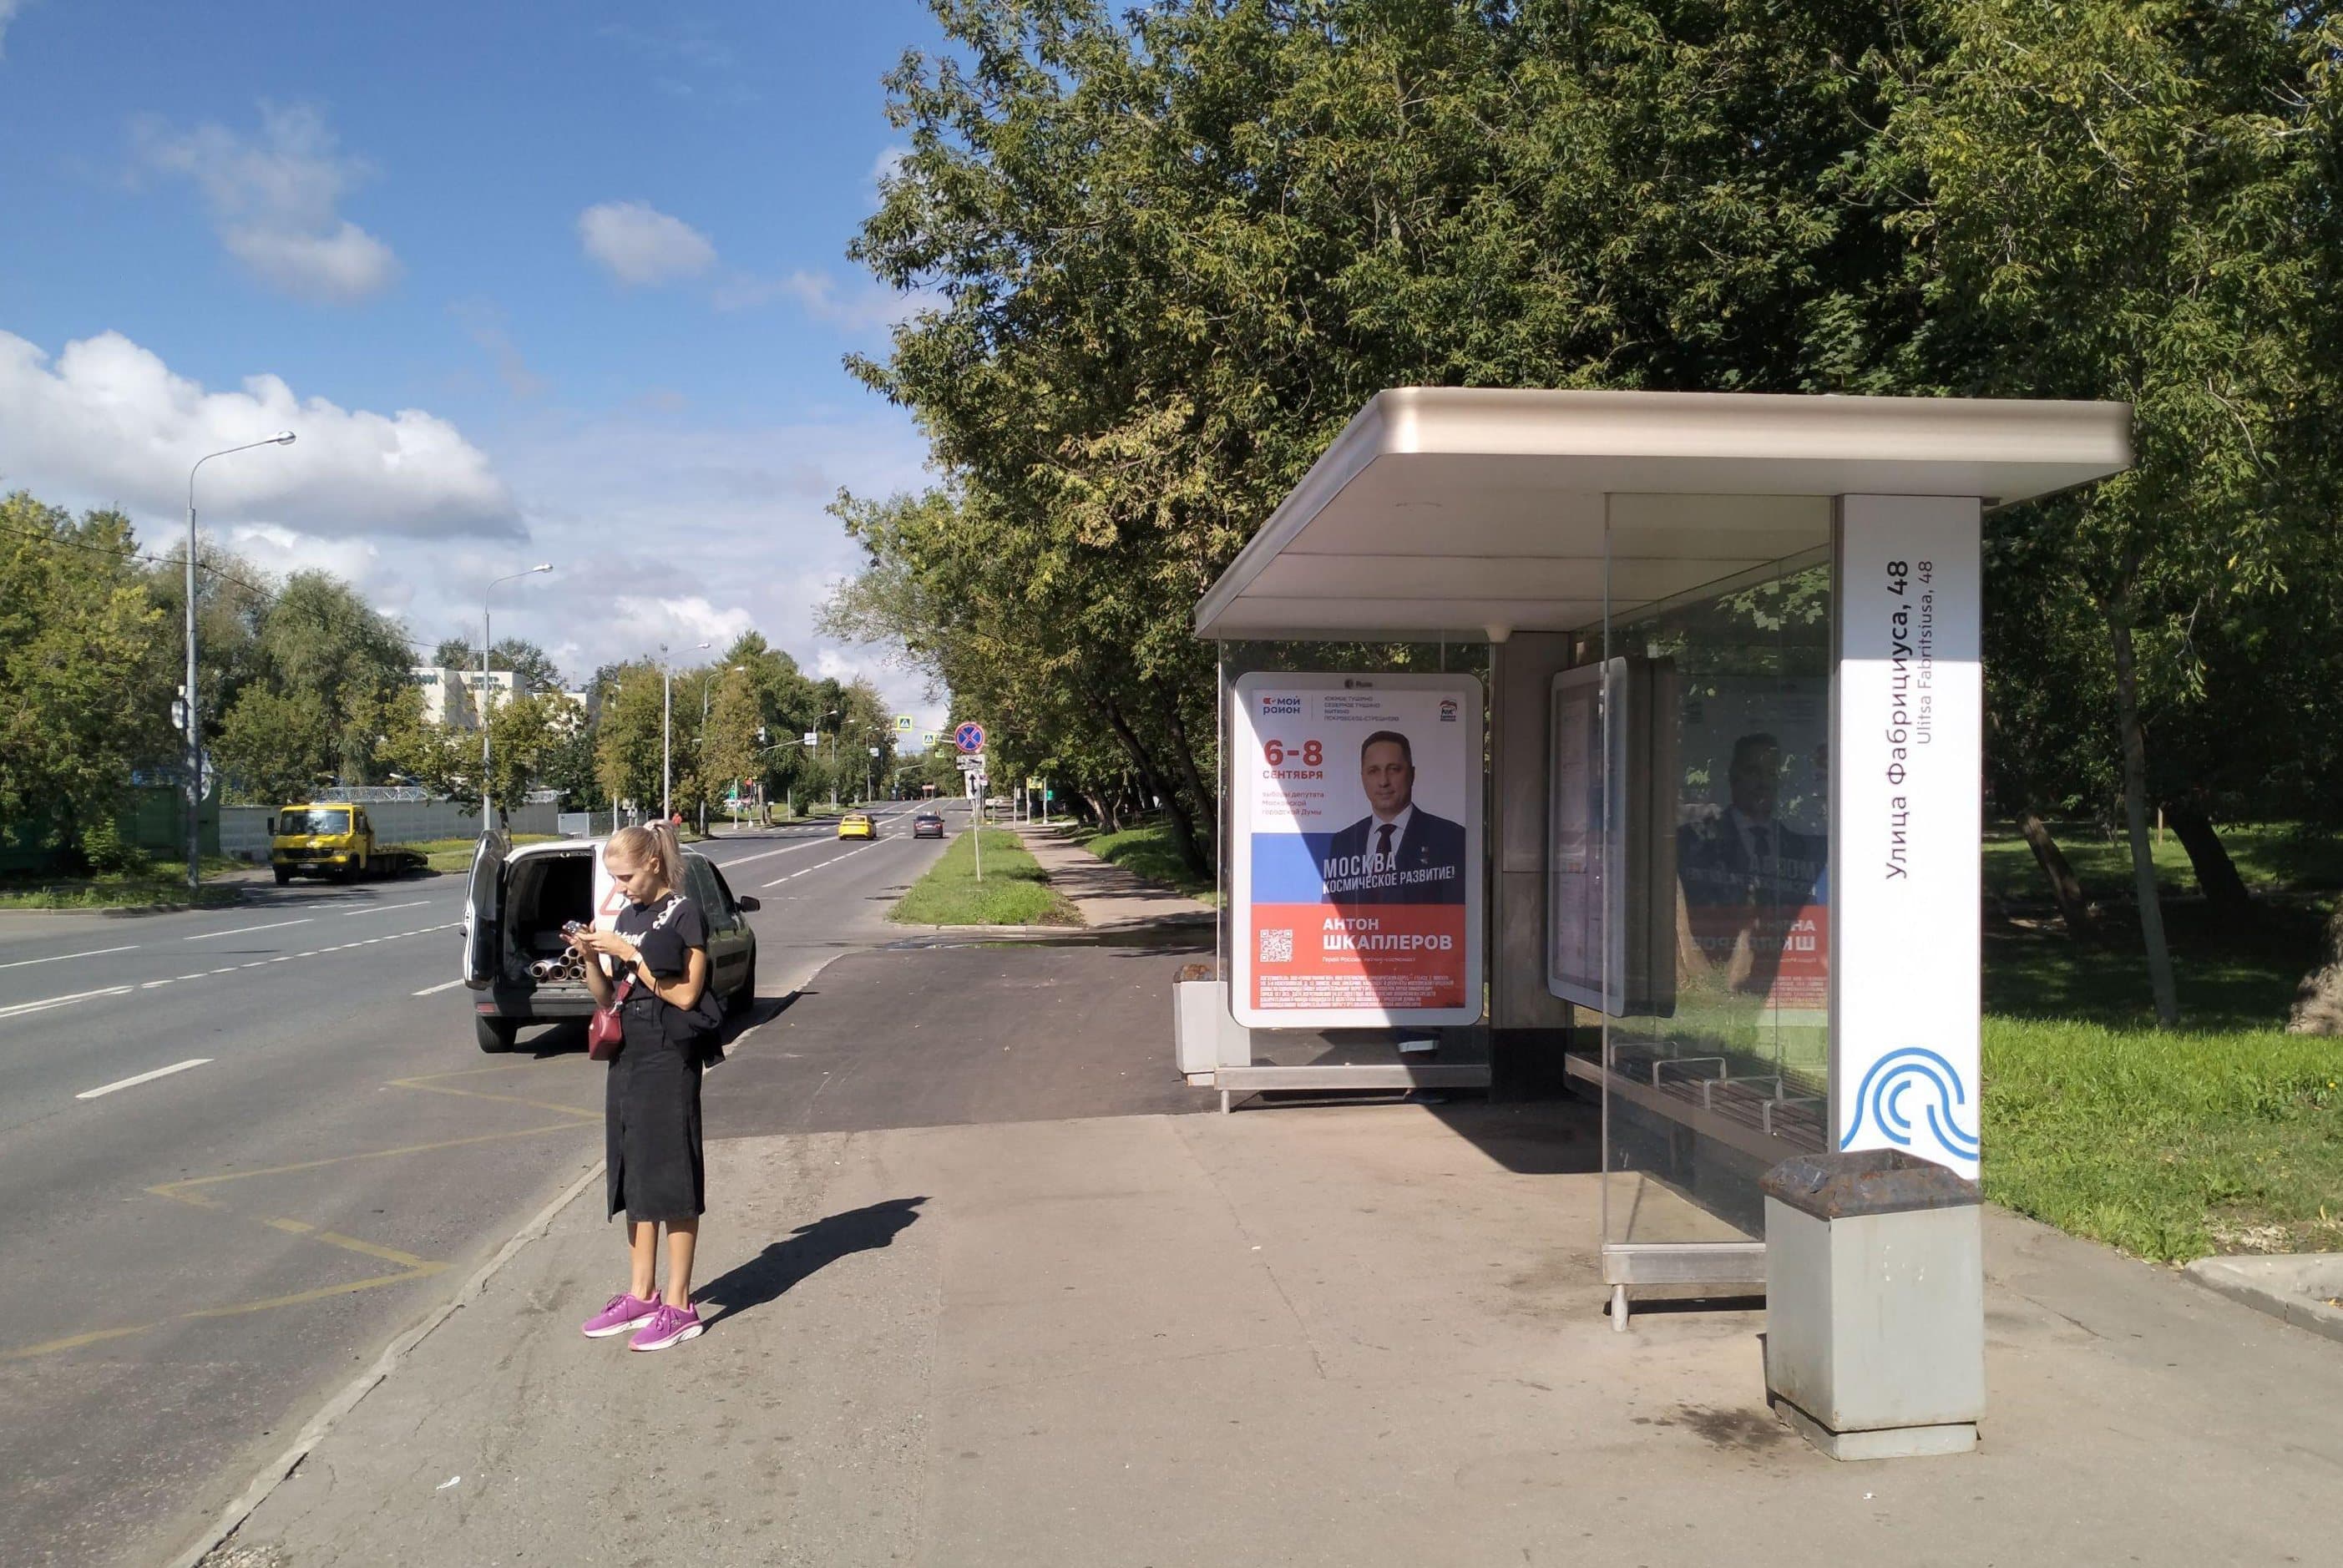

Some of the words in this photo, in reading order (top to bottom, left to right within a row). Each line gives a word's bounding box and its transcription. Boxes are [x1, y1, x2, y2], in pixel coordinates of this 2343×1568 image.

[1887, 560, 1908, 595] 48
[1918, 560, 1933, 584] 48
[1917, 589, 1936, 689] Fabritsiusa,
[1885, 604, 1912, 785] Фабрициуса,
[1916, 695, 1931, 745] Ulitsa
[1263, 770, 1323, 780] СЕНТЯБРЯ
[1885, 796, 1910, 879] Улица
[1323, 852, 1397, 879] МОСКВА
[1323, 873, 1398, 895] КОСМИЧЕСКОЕ
[1399, 865, 1455, 885] РАЗВИТИЕ!
[1323, 918, 1379, 931] АНТОН
[1323, 934, 1453, 950] ШКАПЛЕРОВ
